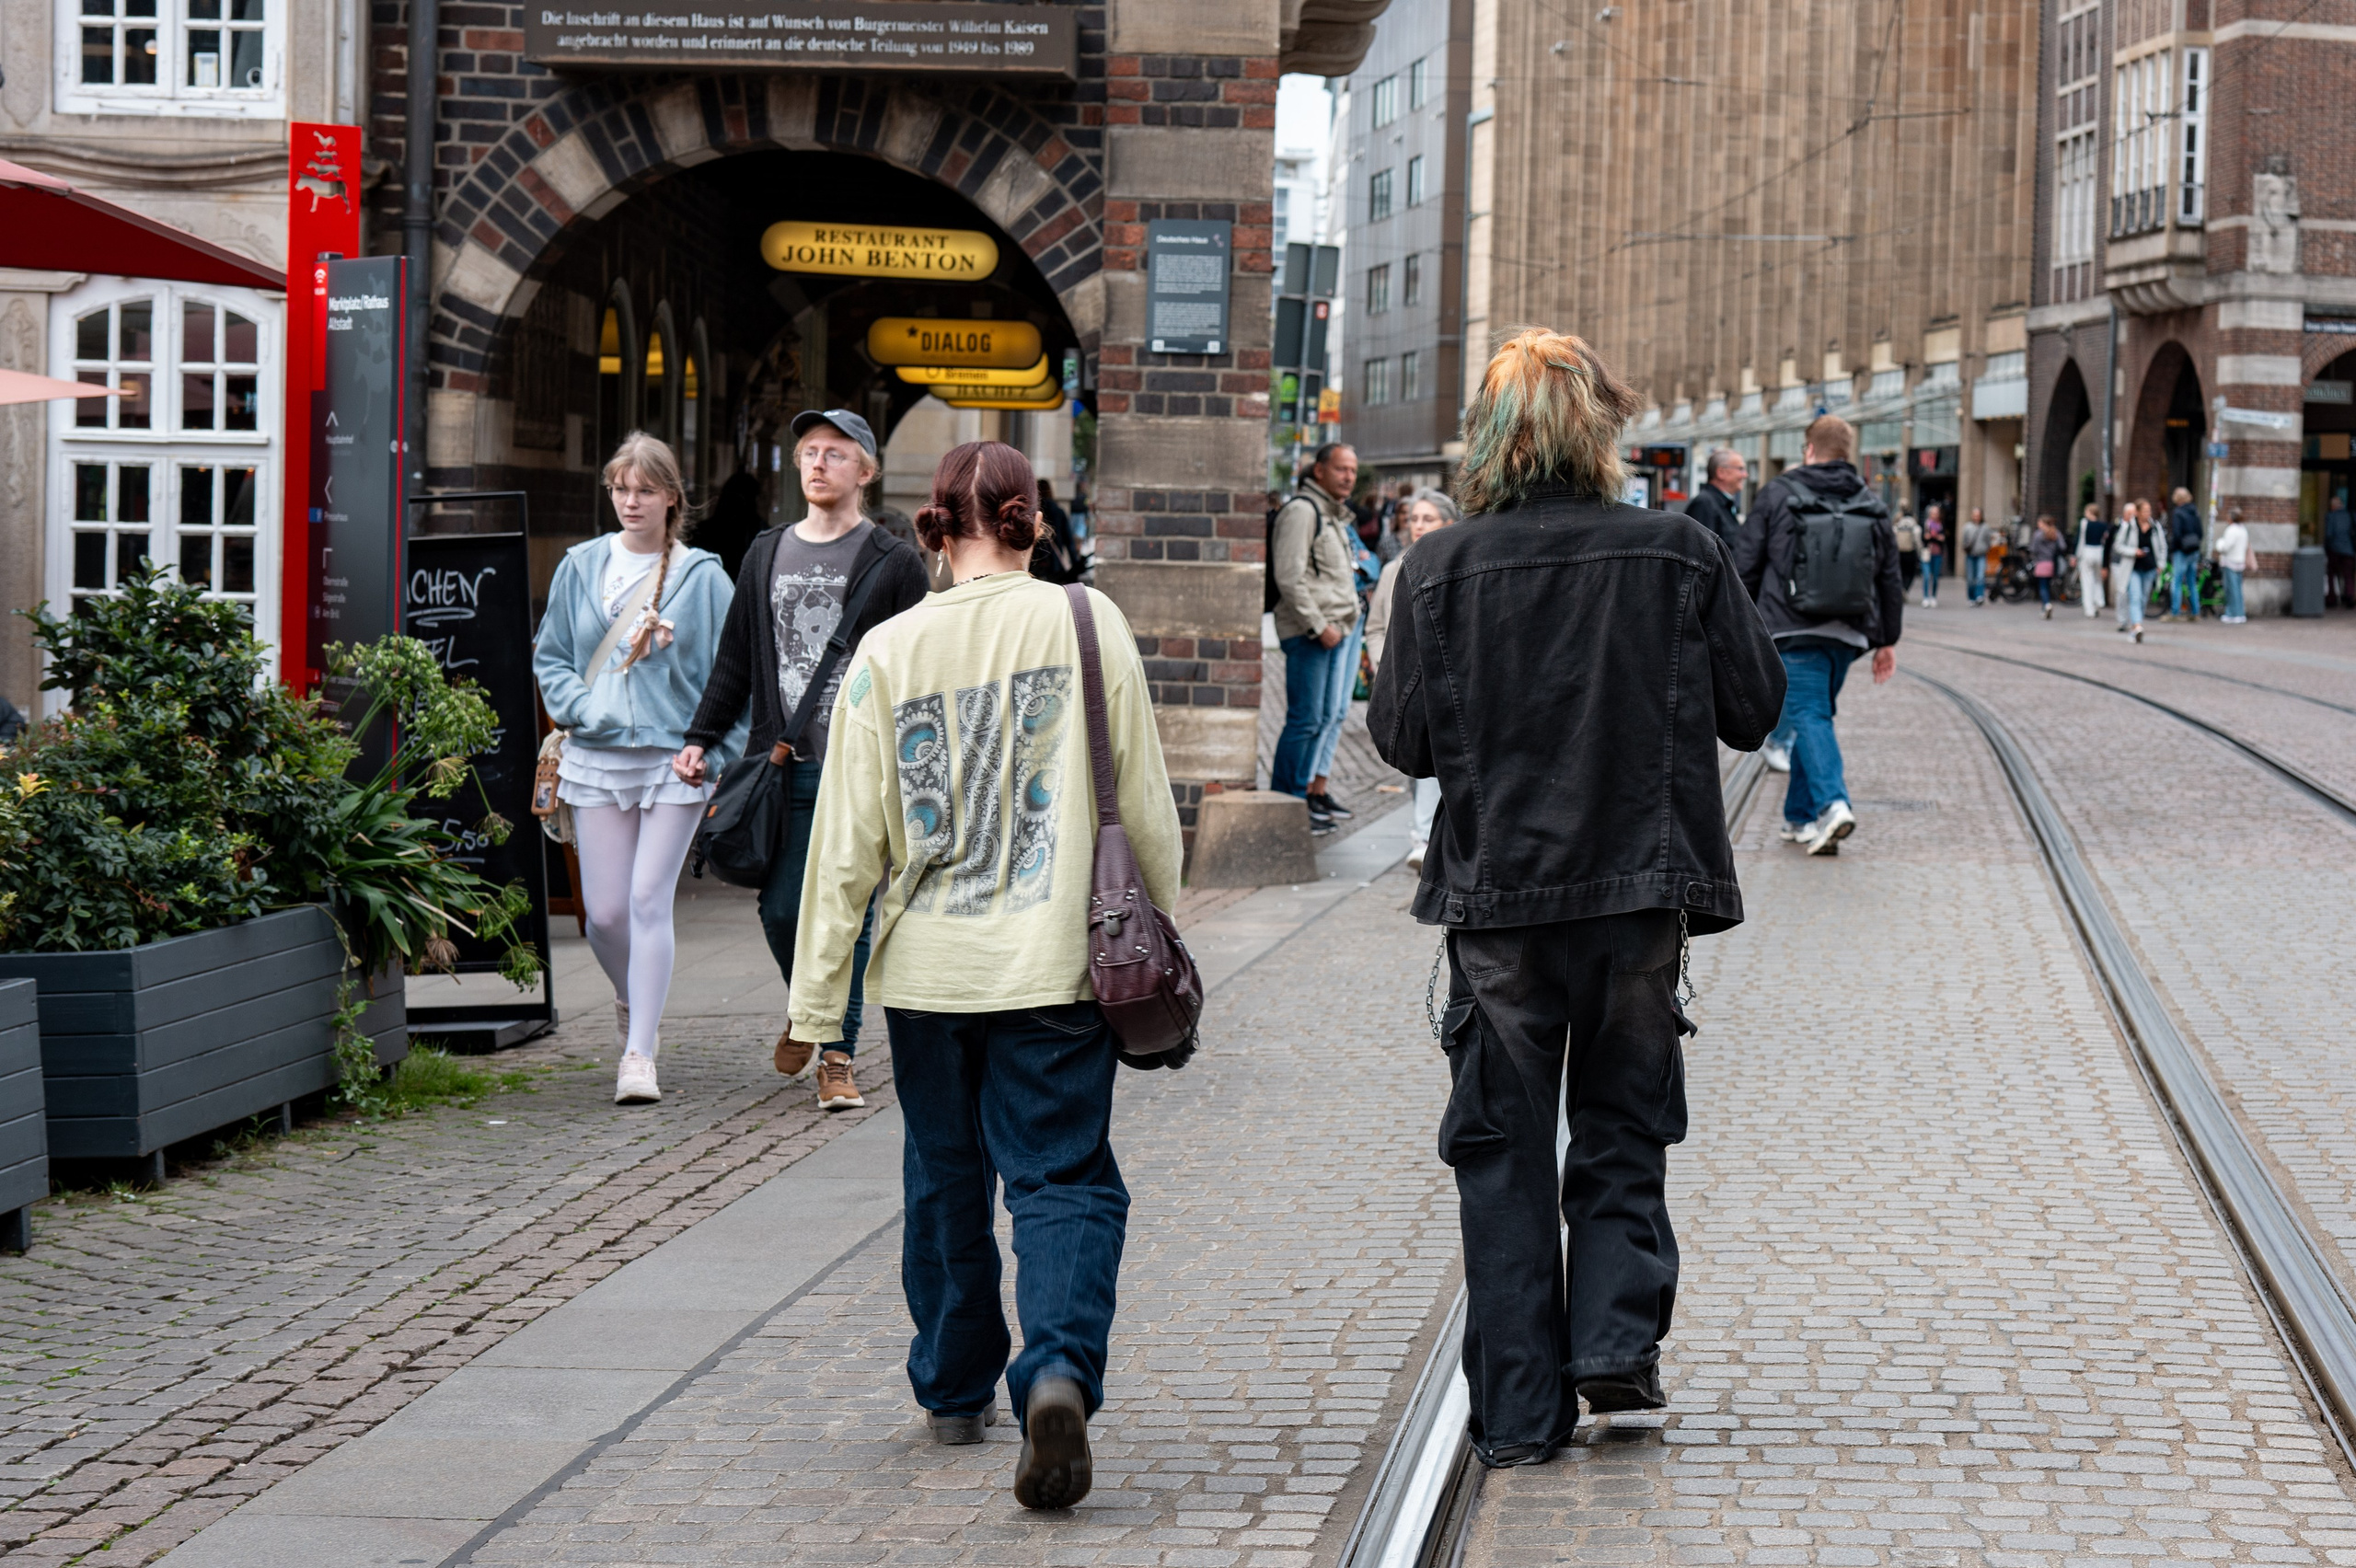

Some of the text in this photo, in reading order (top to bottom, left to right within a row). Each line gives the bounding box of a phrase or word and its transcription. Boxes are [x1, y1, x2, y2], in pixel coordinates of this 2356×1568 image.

[541, 10, 564, 26] Die
[566, 11, 621, 27] Inschrift
[623, 15, 640, 27] an
[642, 12, 688, 28] diesem
[691, 13, 725, 29] Haus
[728, 14, 745, 29] ist
[747, 14, 769, 29] auf
[771, 15, 825, 30] Wunsch
[827, 18, 851, 31] von
[948, 19, 1001, 34] Wilhelm
[1004, 20, 1049, 35] Kaisen
[557, 32, 628, 51] angebracht
[631, 34, 678, 49] worden
[682, 34, 708, 50] und
[710, 35, 762, 50] erinnert
[765, 39, 781, 51] an
[784, 36, 805, 51] die
[807, 37, 866, 52] deutsche
[870, 38, 918, 57] Teilung
[919, 41, 943, 53] von
[980, 41, 1000, 55] bis
[1004, 40, 1034, 55] 1989
[814, 229, 949, 249] RESTAURANT
[782, 246, 976, 271] JOHN BENTON
[328, 316, 353, 330] Altstadt
[922, 332, 991, 352] DIALOG
